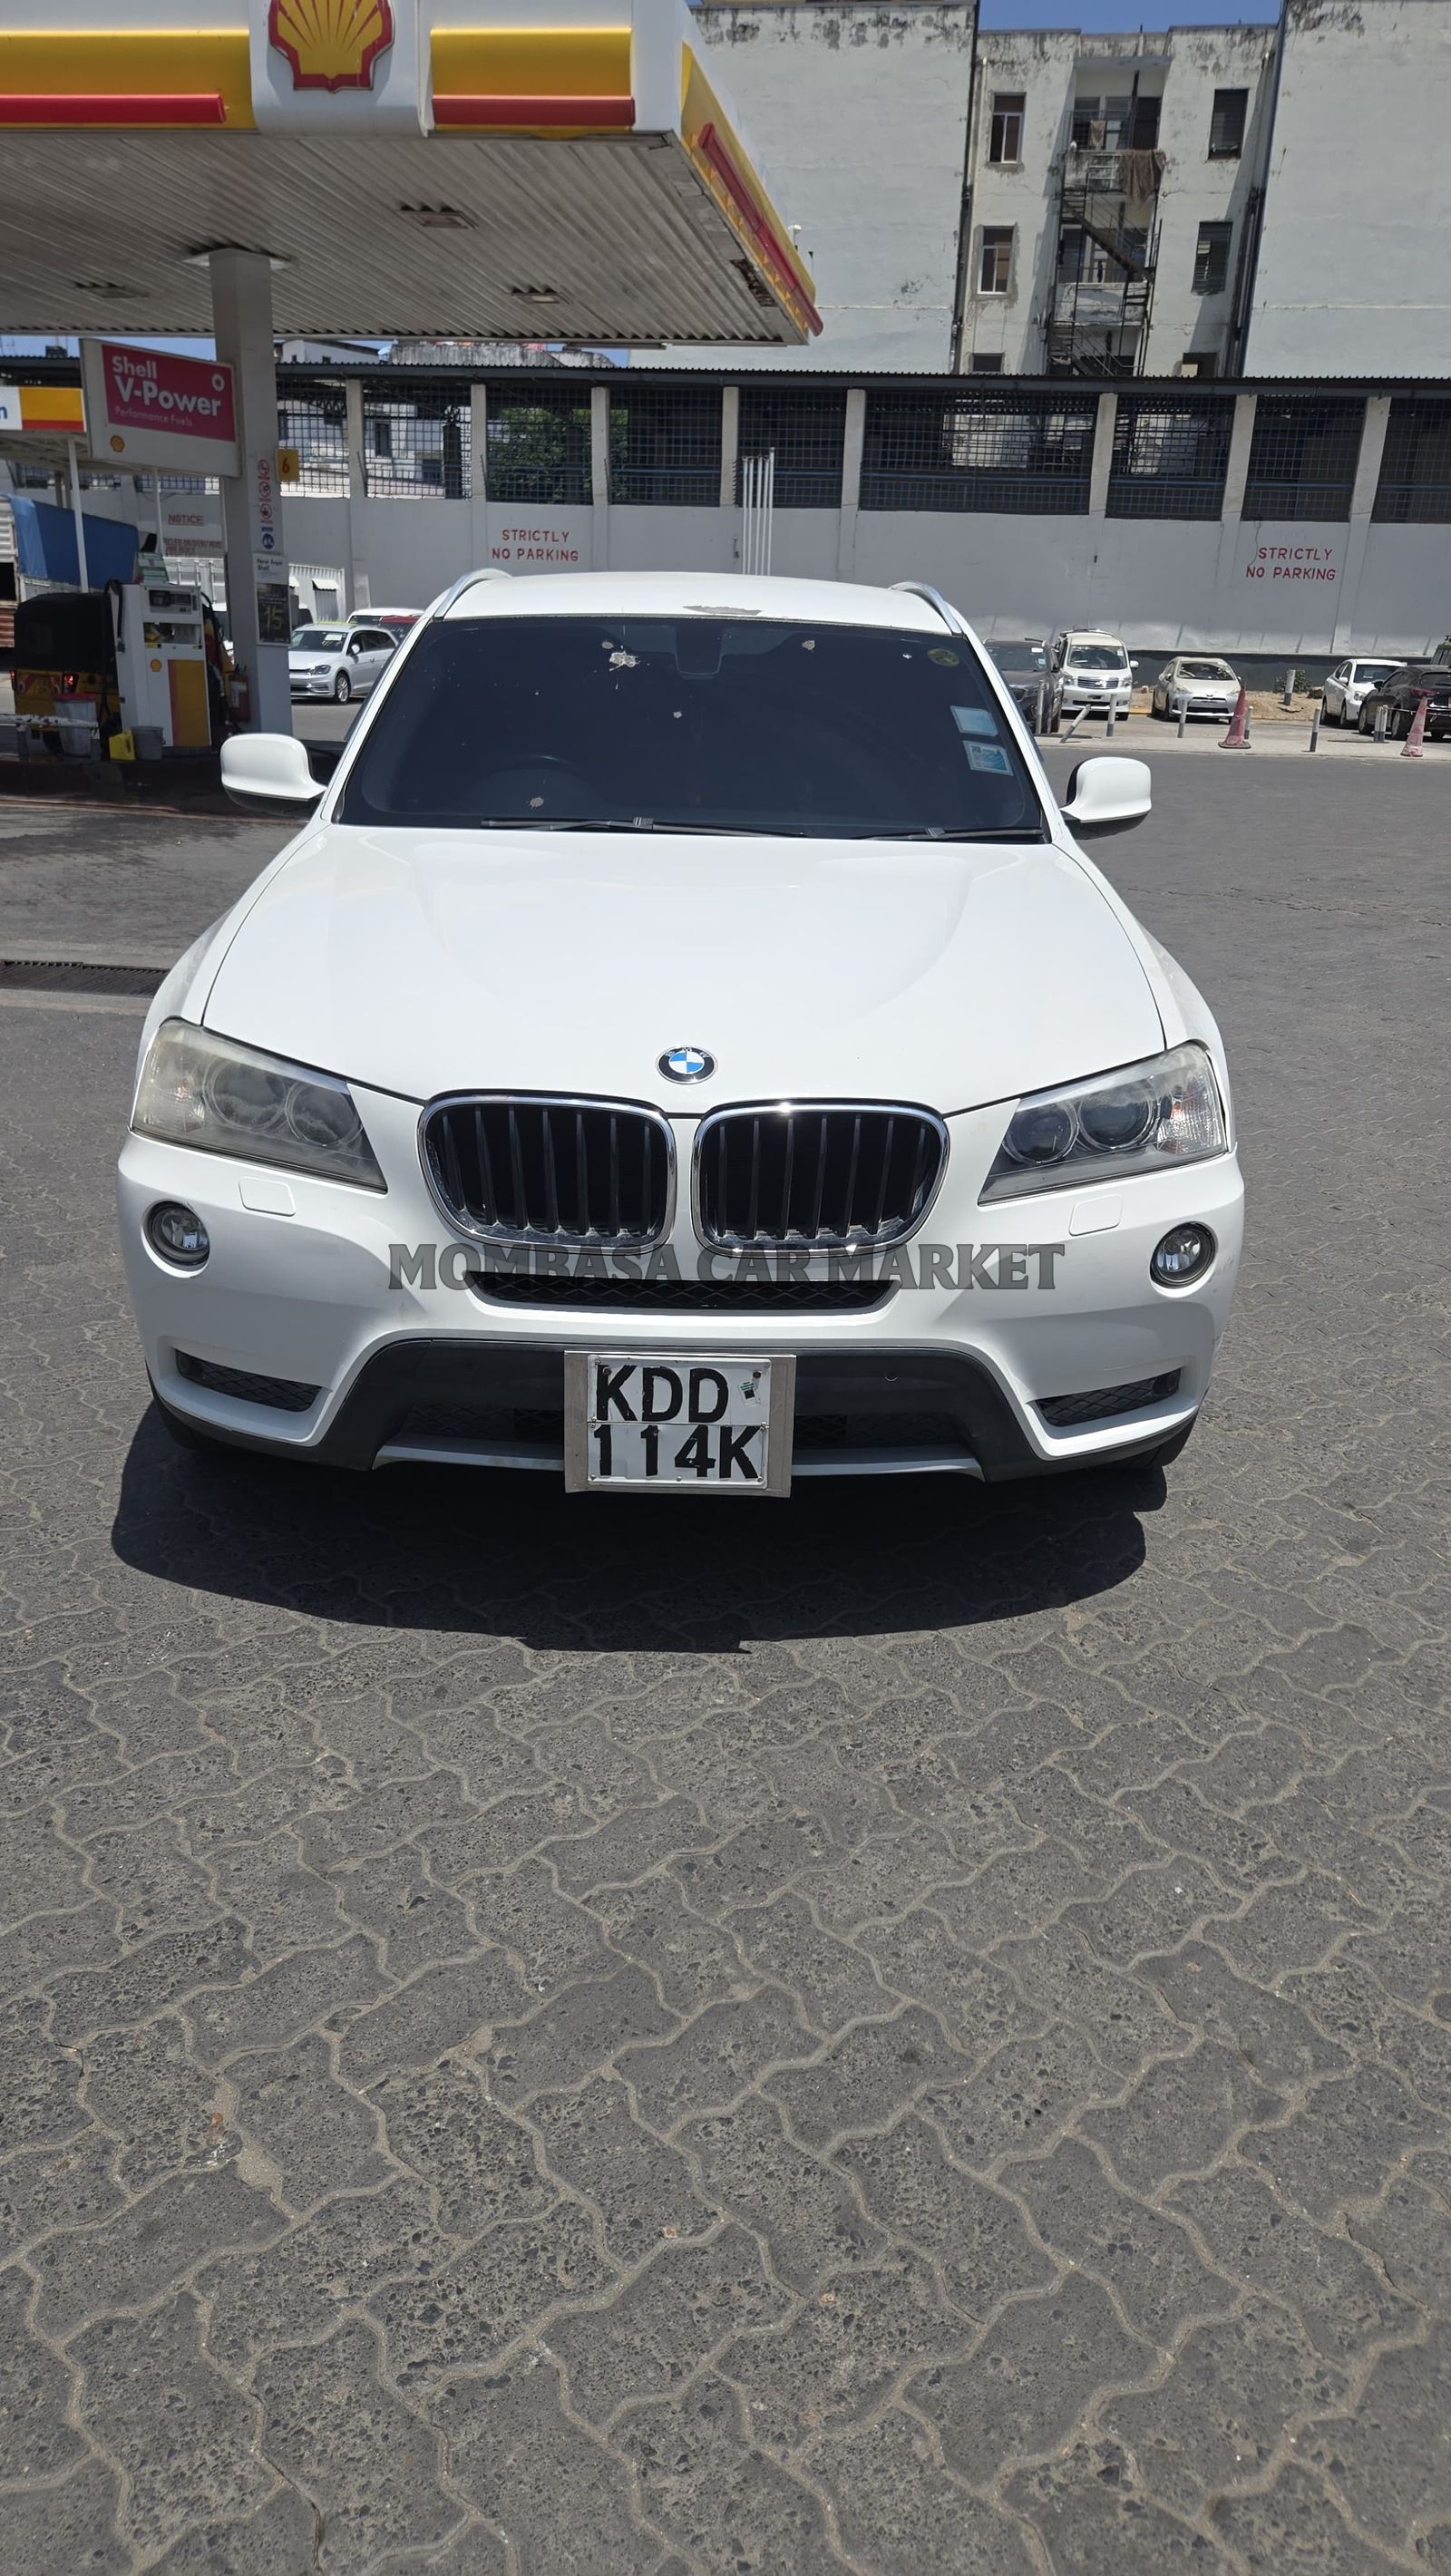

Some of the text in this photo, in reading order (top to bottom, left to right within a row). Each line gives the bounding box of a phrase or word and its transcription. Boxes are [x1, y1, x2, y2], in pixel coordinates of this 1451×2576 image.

[112, 355, 157, 380] Shell
[114, 374, 221, 417] V-Power
[115, 405, 169, 423] Performance
[282, 458, 290, 473] 6
[168, 514, 204, 524] NOTICE
[502, 529, 570, 543] STRICTLY
[492, 548, 579, 562] NO PARKING
[1258, 547, 1333, 560] STRICTLY
[1246, 566, 1337, 581] NO PARKING
[596, 1365, 729, 1423] KDD
[593, 1424, 762, 1479] 114K
